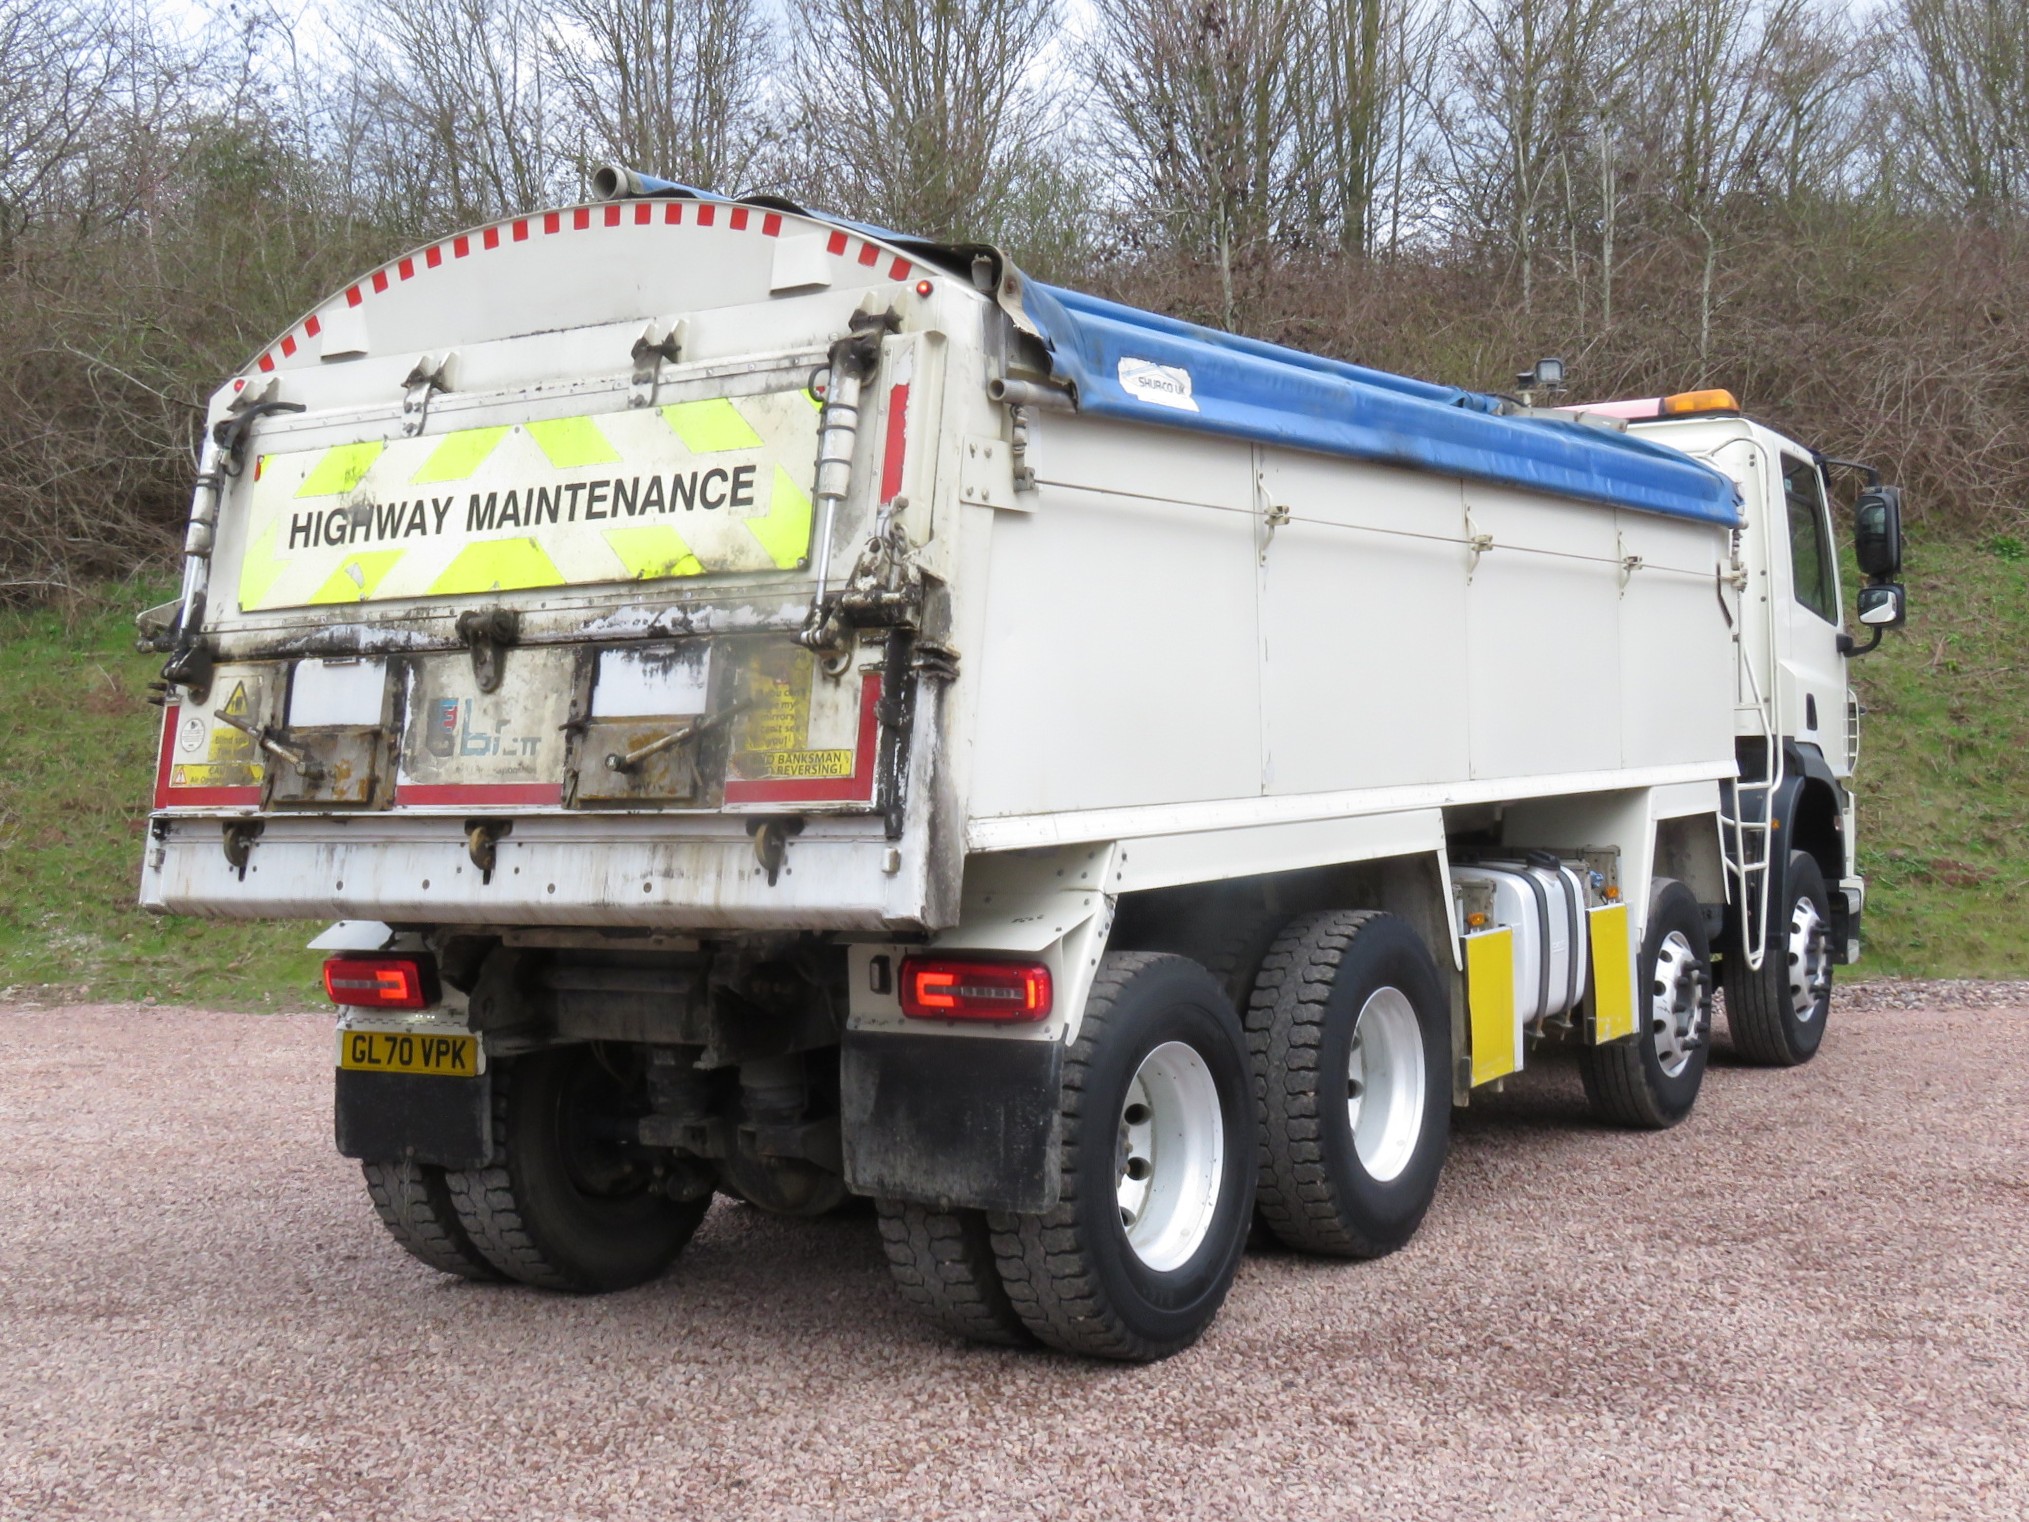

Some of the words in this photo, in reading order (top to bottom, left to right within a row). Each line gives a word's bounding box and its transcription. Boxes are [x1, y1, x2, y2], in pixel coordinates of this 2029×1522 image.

[288, 496, 454, 549] HIGHWAY
[466, 464, 758, 532] MAINTENANCE
[781, 702, 795, 711] my
[777, 753, 841, 765] BANKSMAN
[776, 764, 843, 776] REVERSING!
[352, 1035, 413, 1066] GL70
[421, 1038, 466, 1069] VPK
